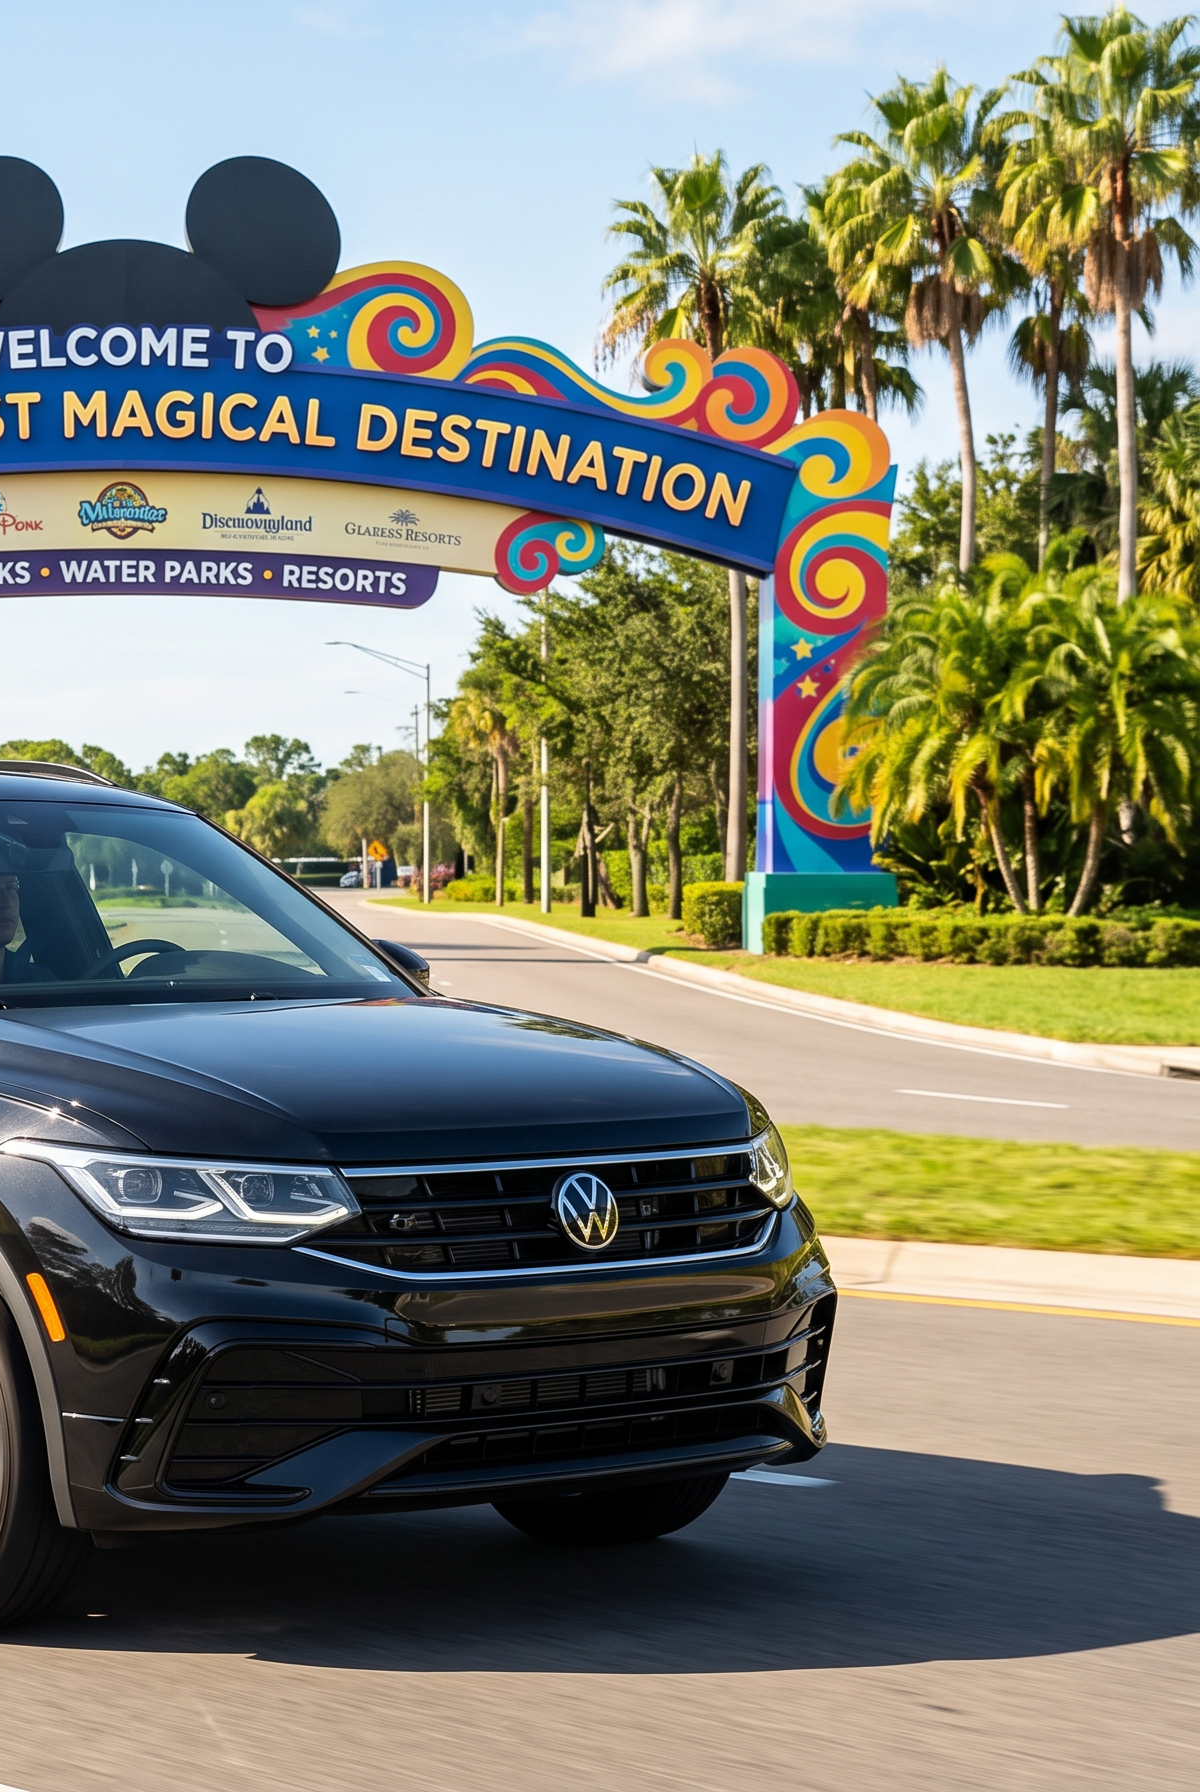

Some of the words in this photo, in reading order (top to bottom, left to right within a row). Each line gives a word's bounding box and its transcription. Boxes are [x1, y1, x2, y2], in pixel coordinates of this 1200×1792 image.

[226, 330, 293, 373] TO
[64, 390, 335, 447] MAGICAL
[357, 404, 751, 526] DESTINATION
[344, 521, 403, 540] GLARESS
[404, 528, 462, 547] RESORTS
[59, 560, 156, 583] WATER
[164, 560, 253, 586] PARKS
[282, 564, 407, 596] RESORTS
